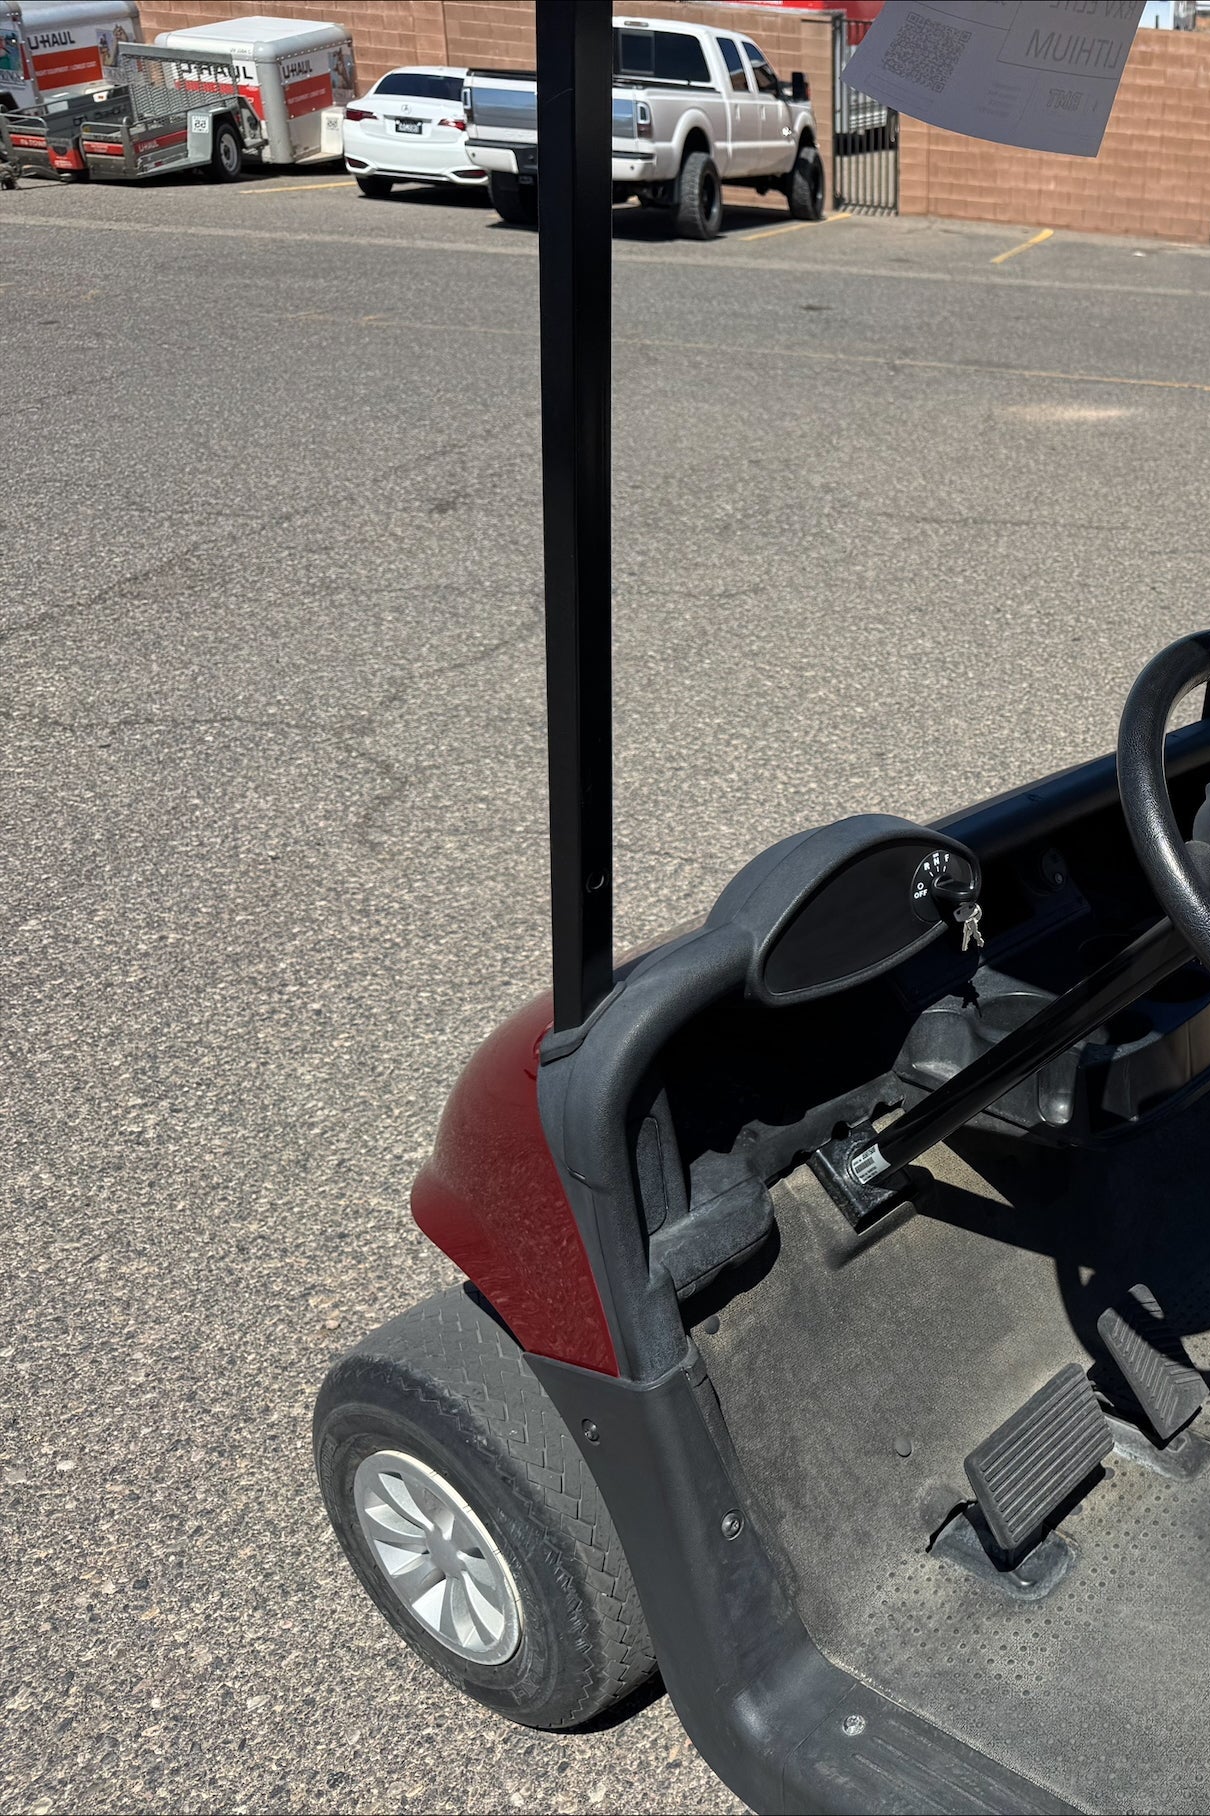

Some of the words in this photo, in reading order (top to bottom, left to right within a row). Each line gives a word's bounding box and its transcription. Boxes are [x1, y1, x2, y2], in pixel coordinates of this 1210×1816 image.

[27, 31, 75, 49] U-HAUL
[282, 60, 313, 79] U-HAUL
[944, 853, 950, 862] F
[923, 862, 930, 871] R
[913, 889, 928, 899] OFF
